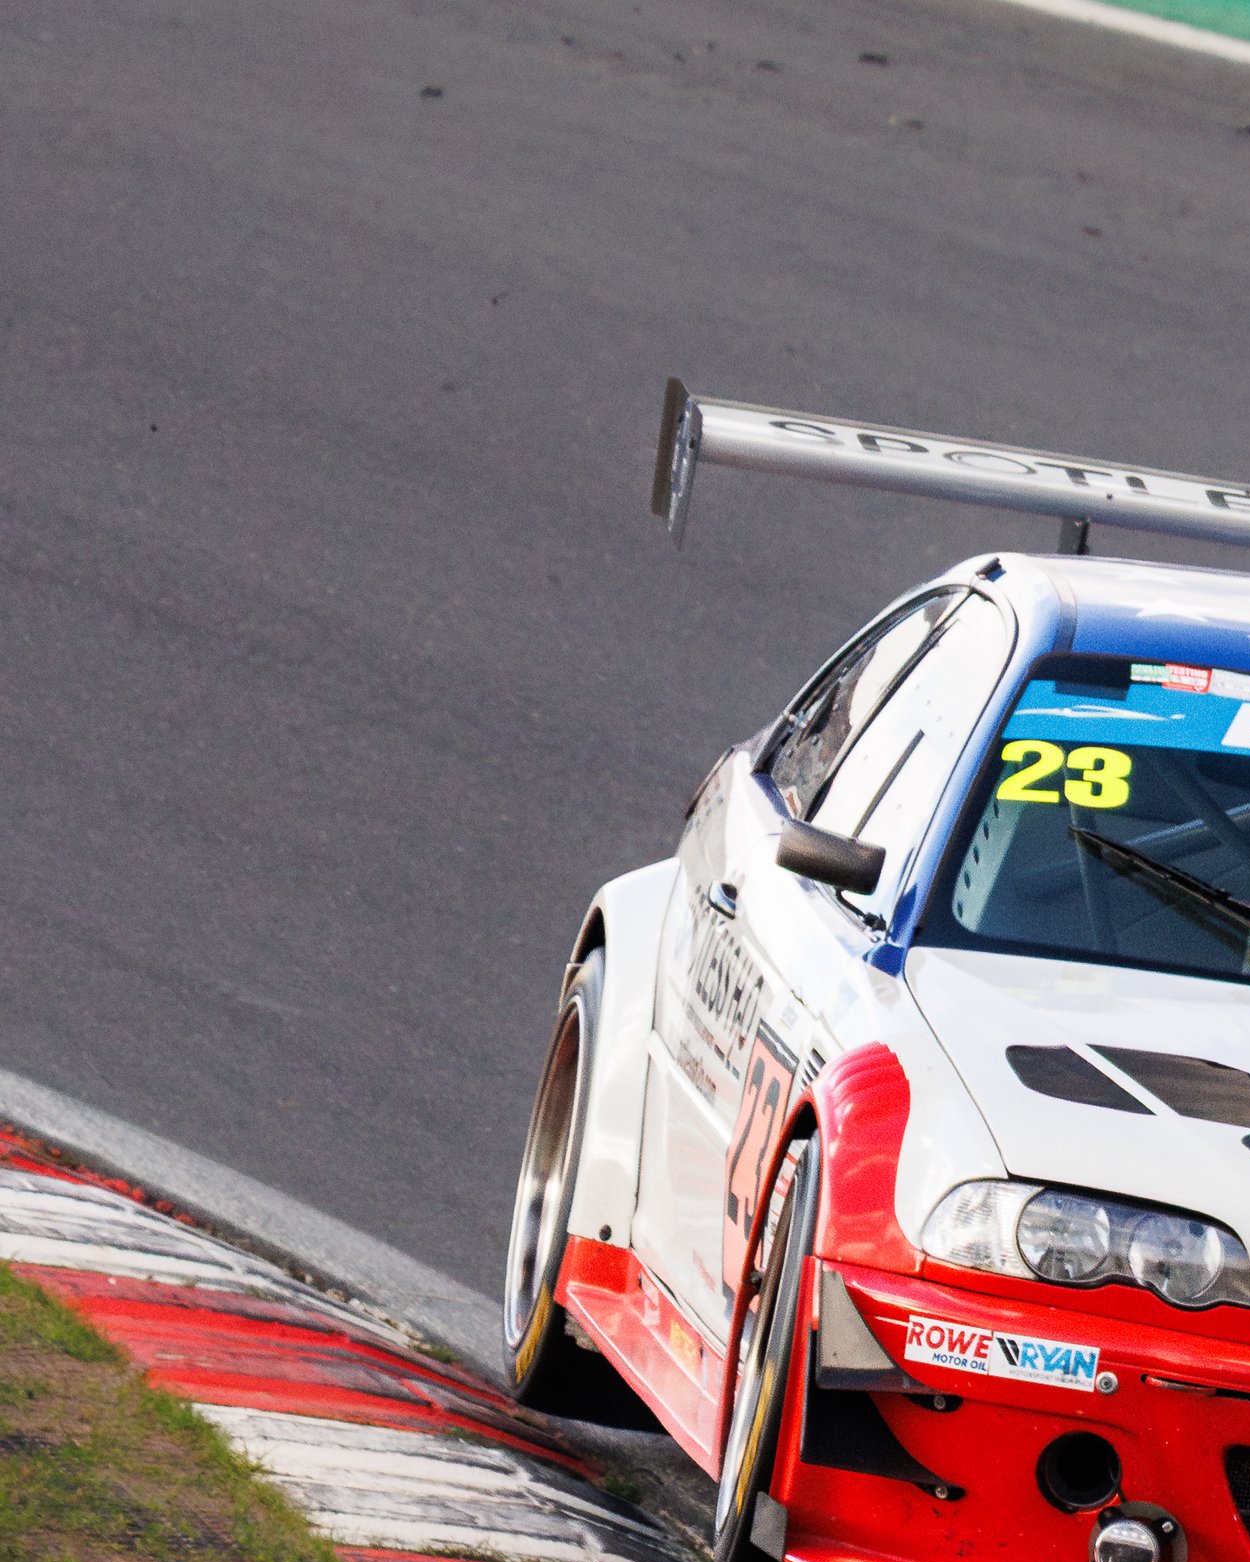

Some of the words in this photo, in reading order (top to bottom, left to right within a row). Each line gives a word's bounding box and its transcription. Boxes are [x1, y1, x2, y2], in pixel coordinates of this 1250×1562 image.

[997, 740, 1131, 809] 23
[908, 1322, 992, 1359] ROWE
[932, 1353, 967, 1367] MOTOR
[970, 1361, 987, 1371] OIL
[1020, 1343, 1096, 1379] RYAN
